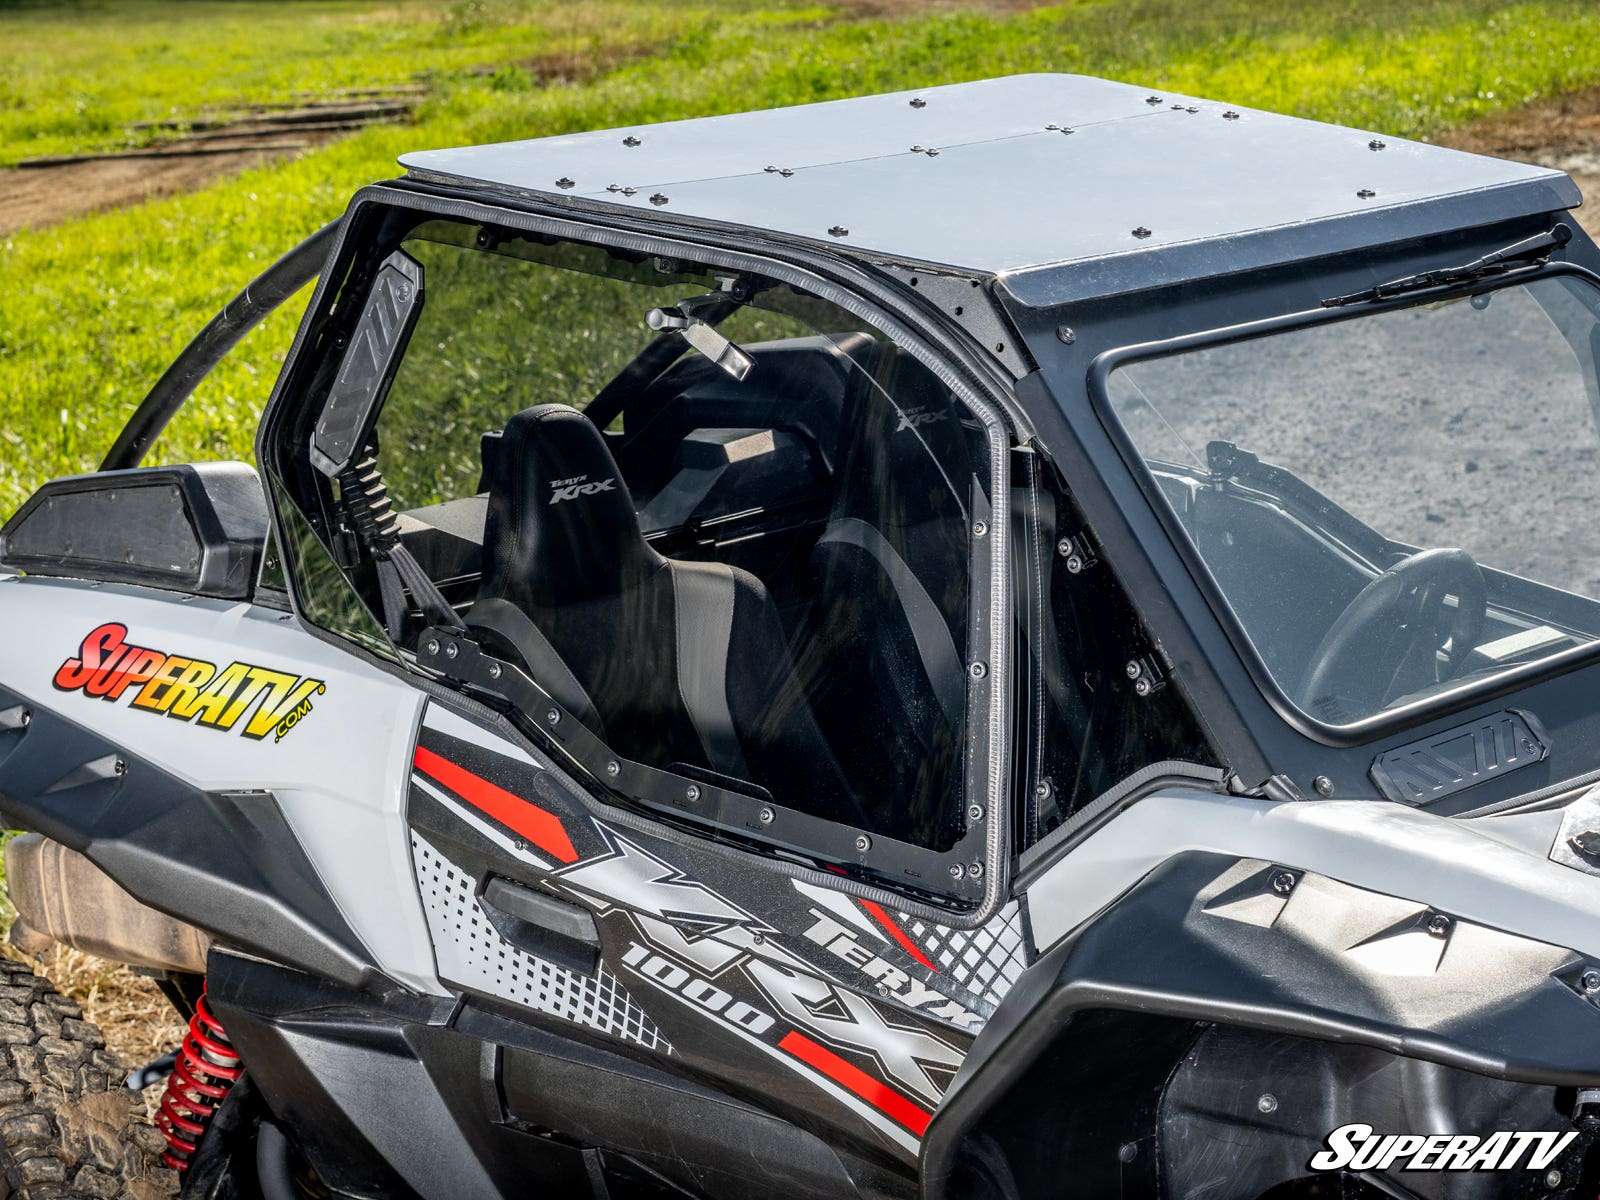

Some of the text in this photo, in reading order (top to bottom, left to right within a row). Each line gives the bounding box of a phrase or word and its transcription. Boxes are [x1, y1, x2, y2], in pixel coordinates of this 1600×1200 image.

[549, 478, 616, 504] KRX
[621, 942, 776, 1035] 1000
[802, 907, 986, 1028] TERYX
